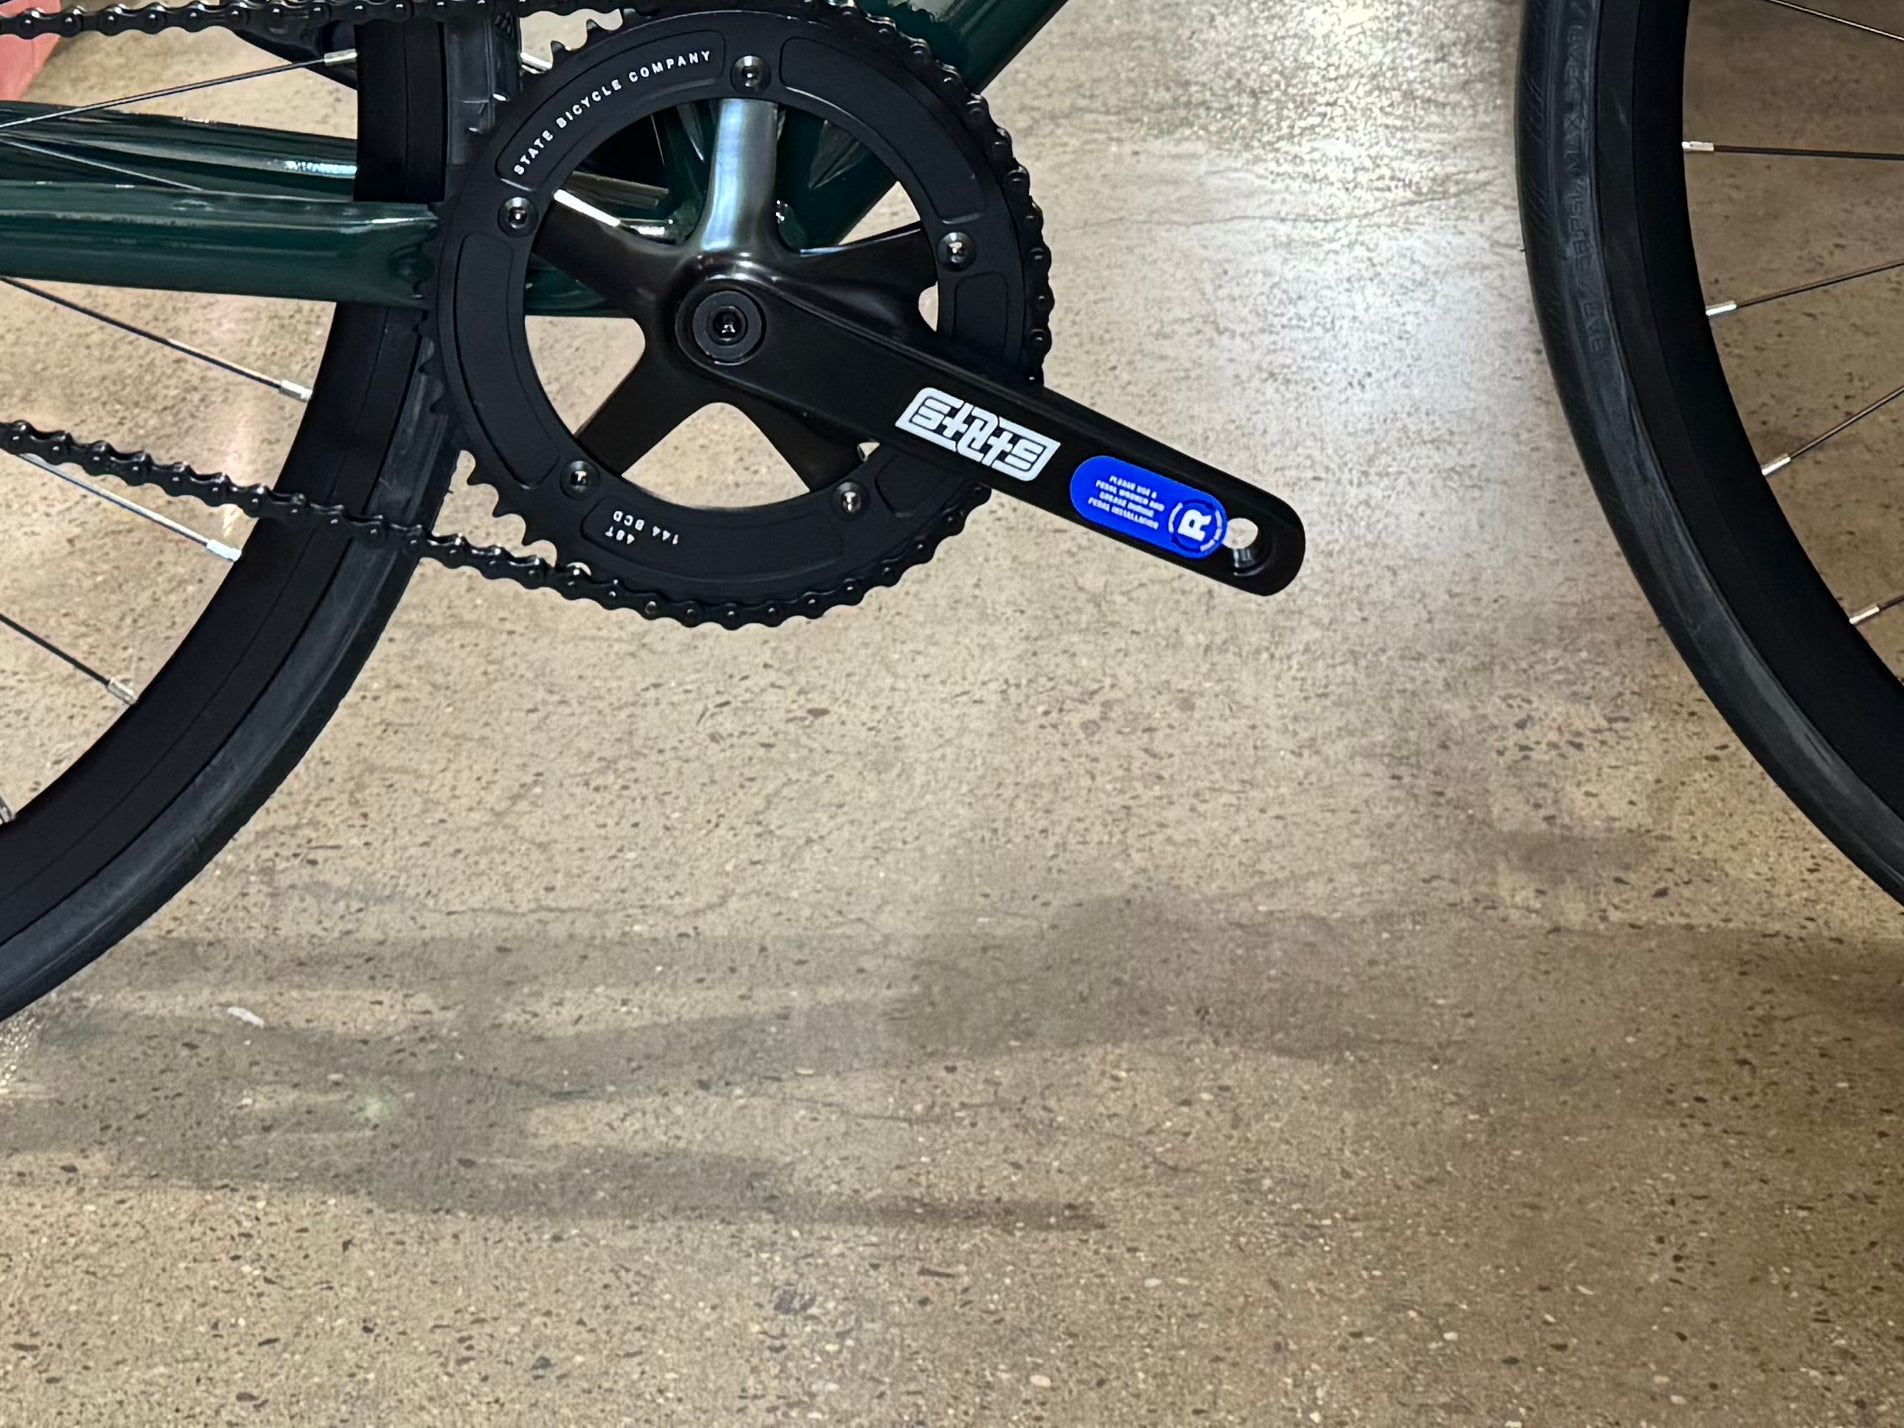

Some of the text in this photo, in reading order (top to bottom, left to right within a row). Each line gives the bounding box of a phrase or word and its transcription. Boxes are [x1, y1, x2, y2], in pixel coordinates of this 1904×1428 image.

[513, 49, 711, 176] STATE BICYCLE COMPANY
[1177, 509, 1213, 542] R
